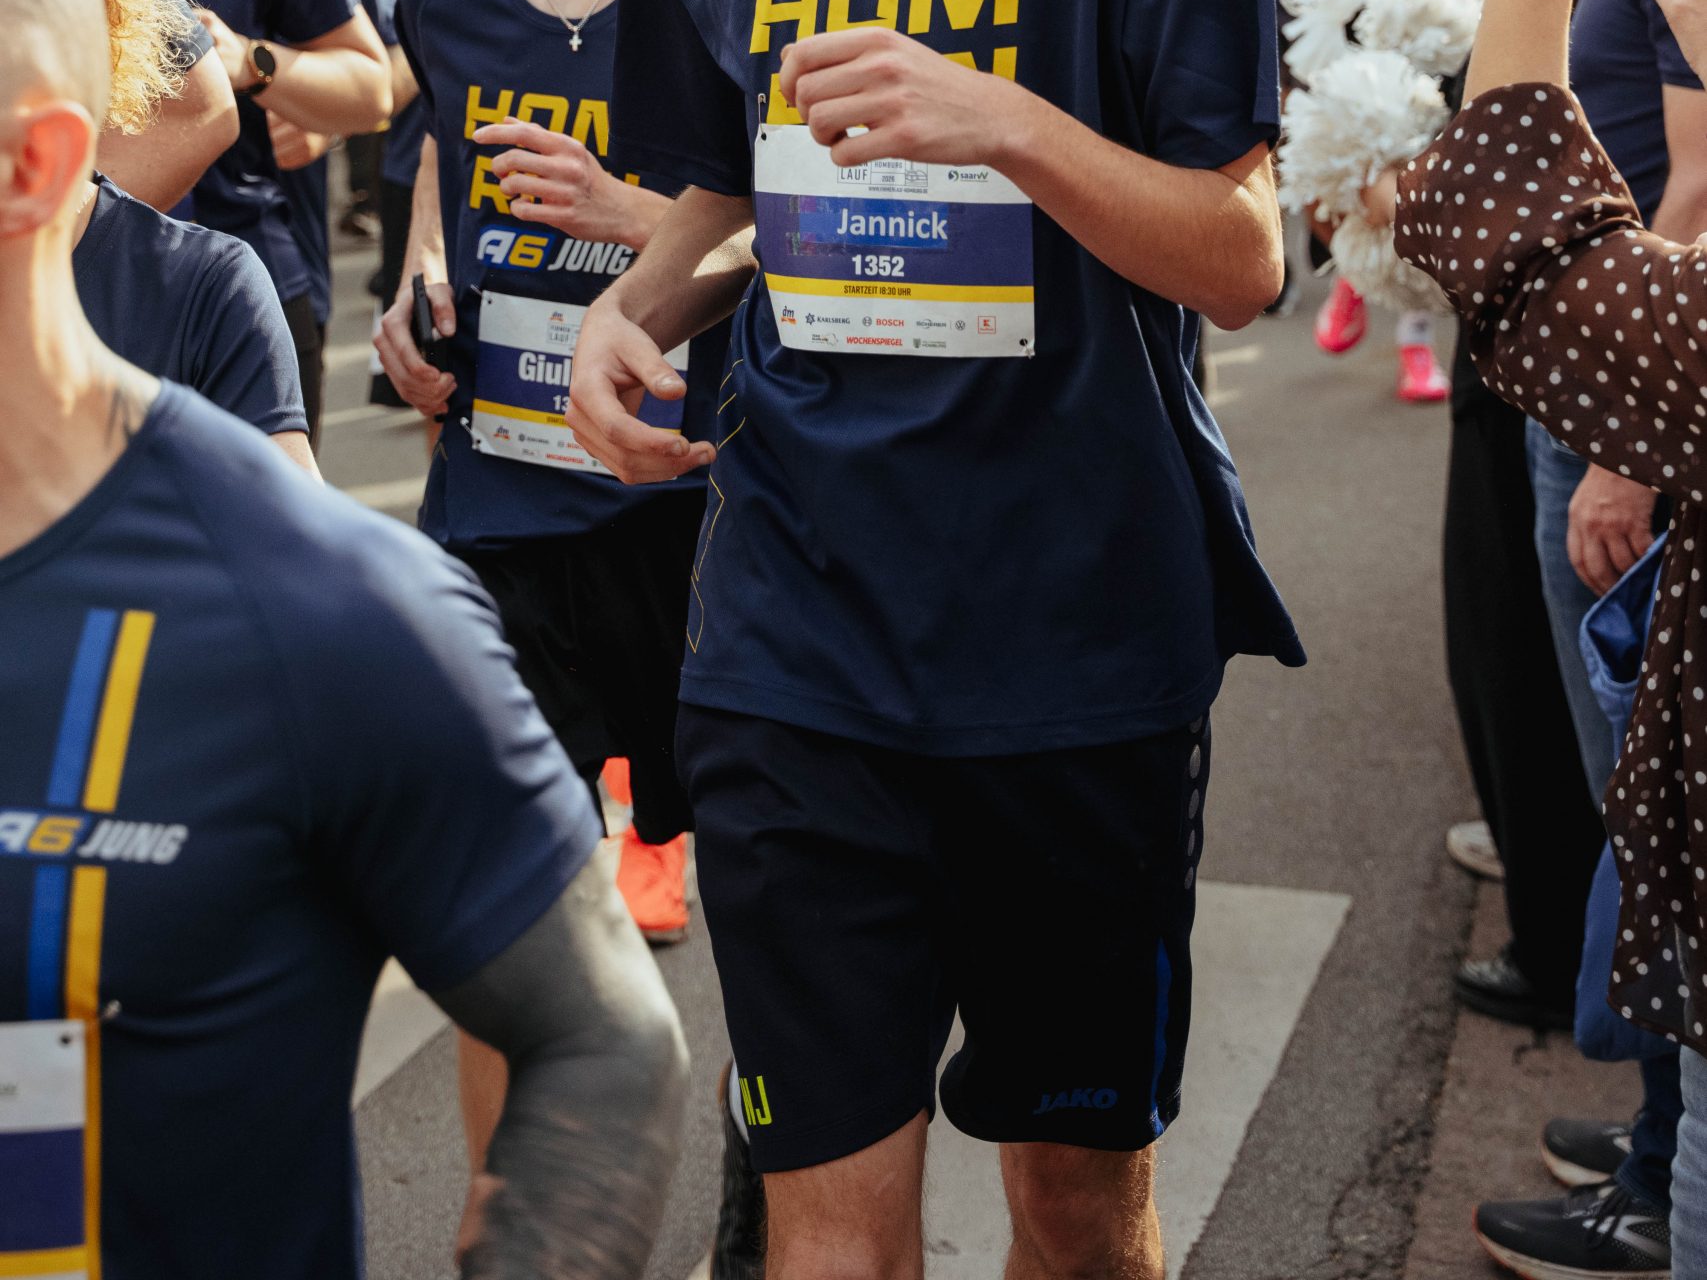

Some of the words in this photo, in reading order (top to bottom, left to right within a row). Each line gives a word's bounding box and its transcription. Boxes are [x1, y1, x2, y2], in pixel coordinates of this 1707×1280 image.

[874, 161, 903, 169] HOMBURG
[840, 168, 868, 181] LAUF
[836, 207, 949, 240] Jannick
[477, 229, 549, 269] A6
[547, 237, 634, 275] JUNG
[852, 254, 905, 277] 1352
[843, 285, 878, 295] STARTZEIT
[879, 286, 897, 296] 18:30
[898, 287, 912, 297] UHR
[782, 305, 795, 318] dm
[817, 316, 851, 325] KARLSBERG
[876, 317, 904, 327] BOSCH
[846, 336, 903, 347] WOCHENSPIEGEL
[552, 395, 570, 411] 13
[76, 819, 190, 865] JUNG
[1032, 1087, 1118, 1116] JAKO
